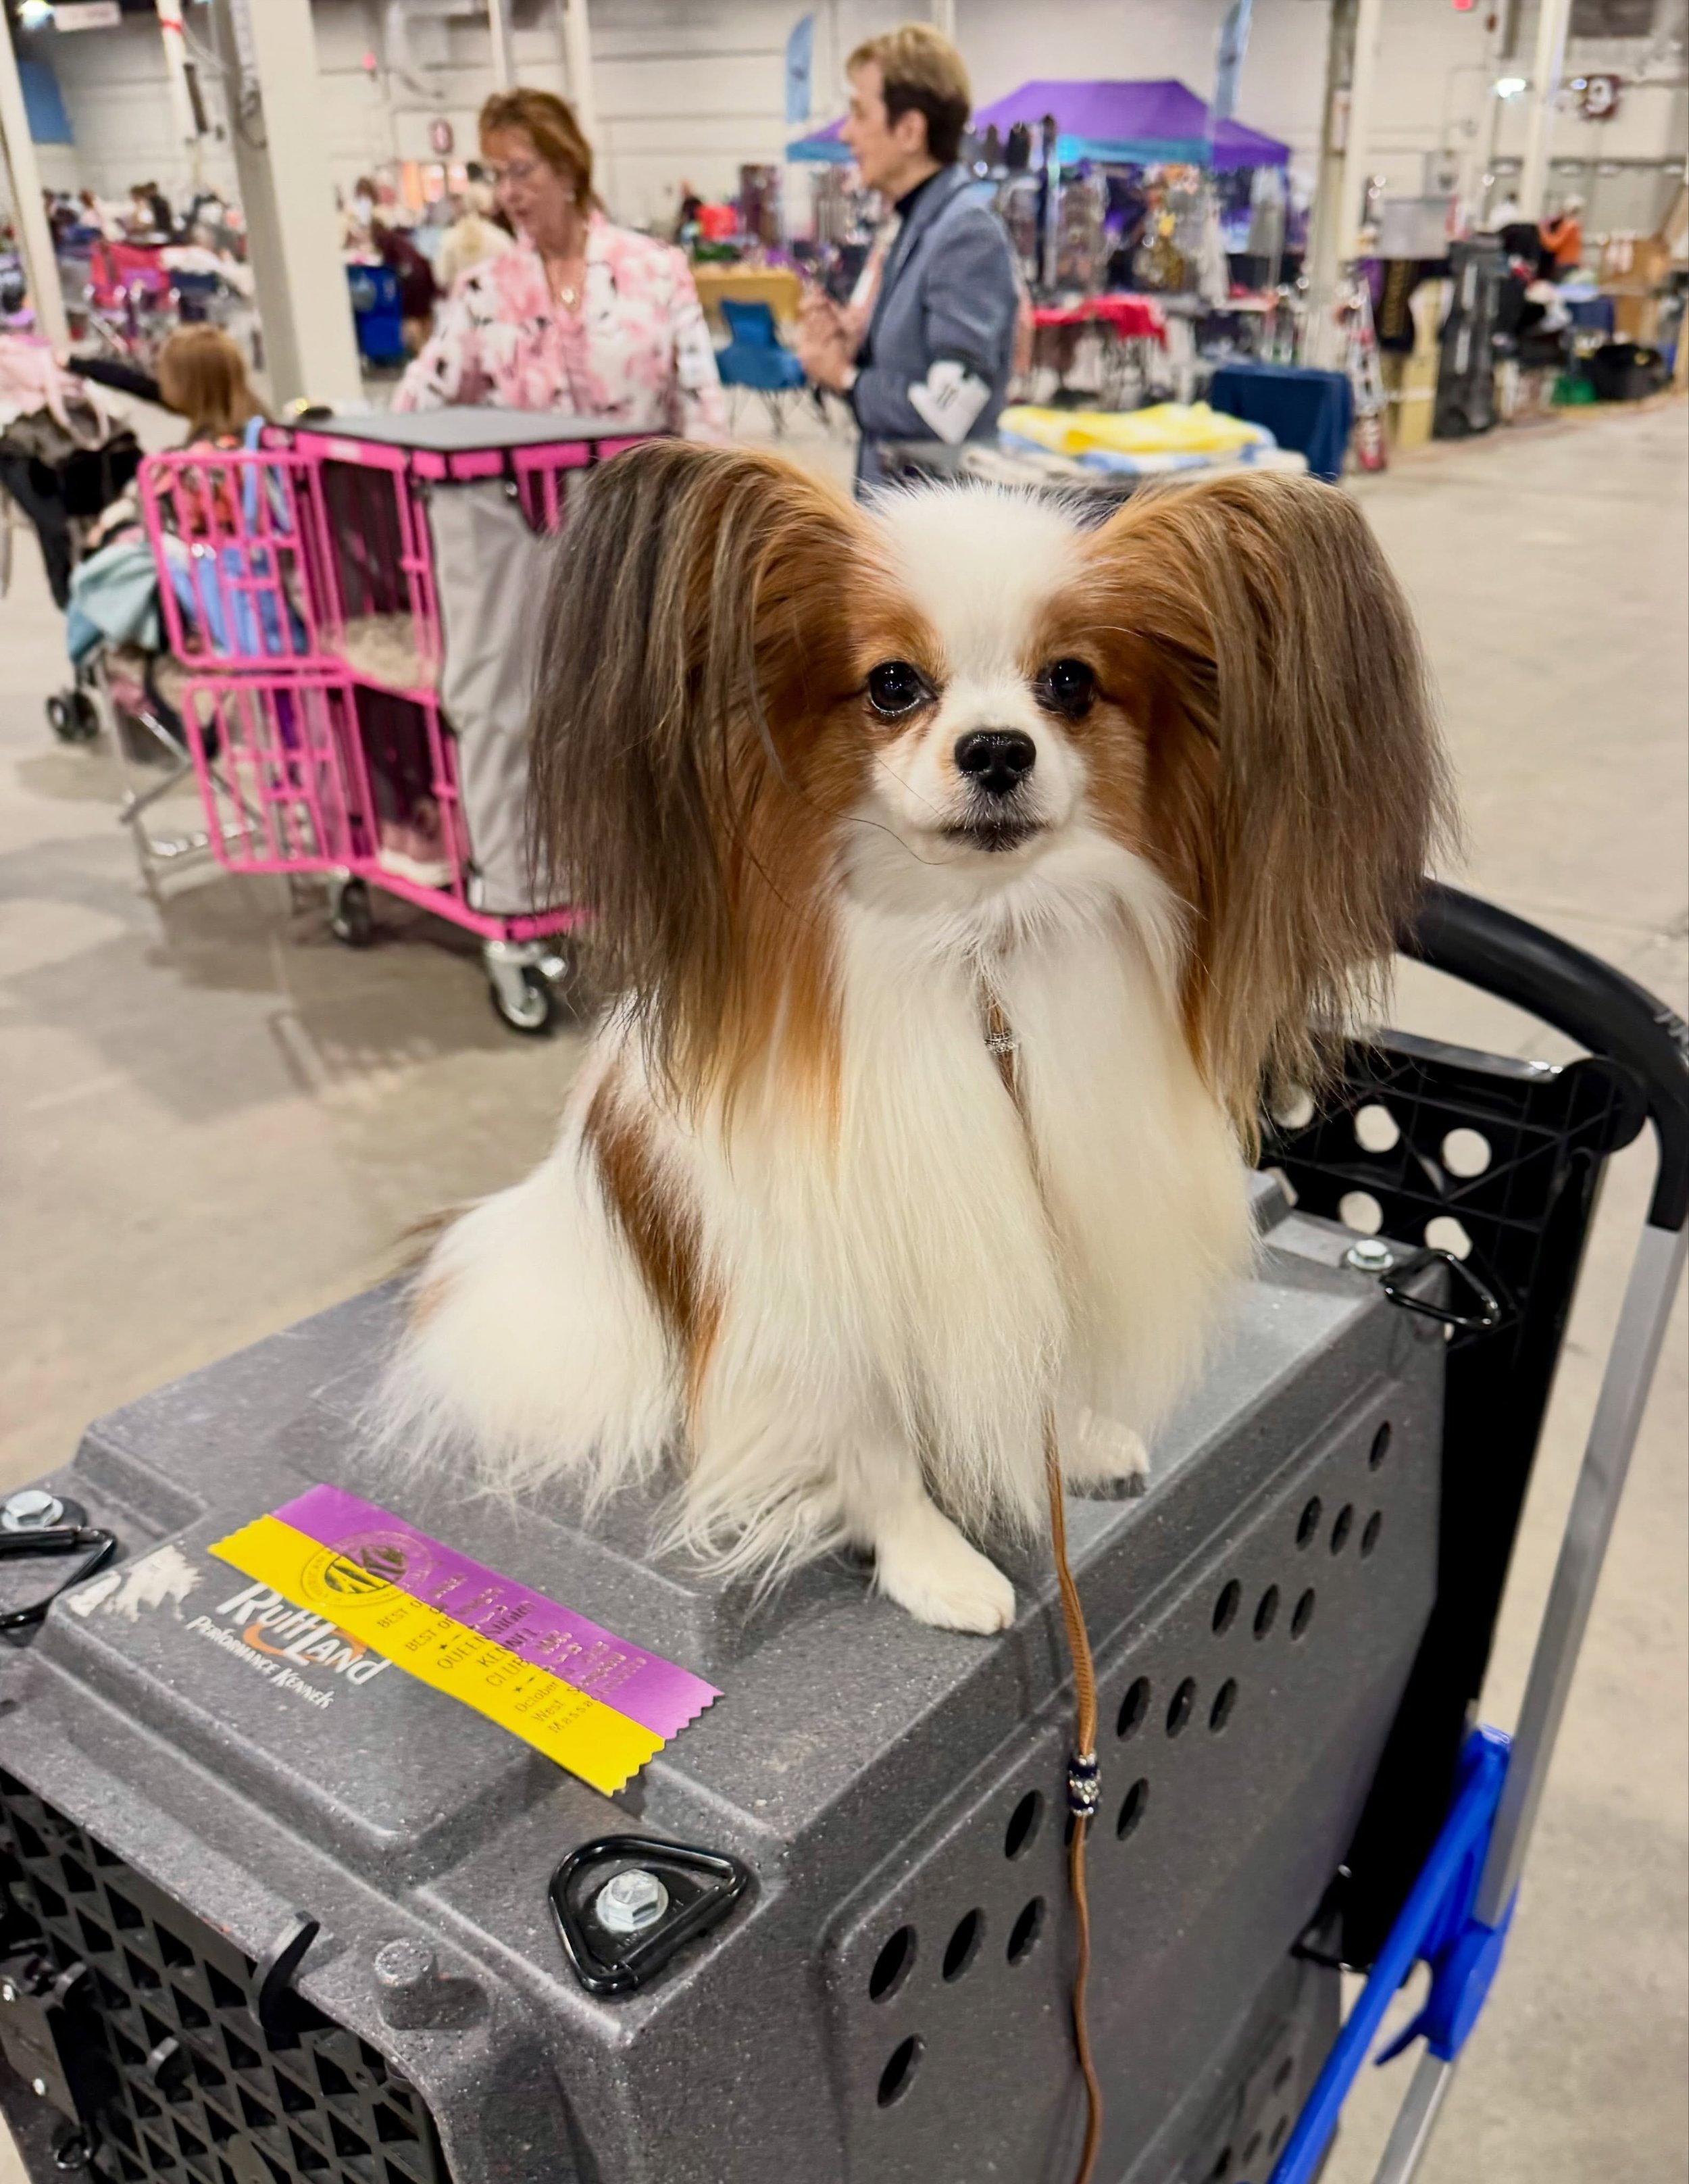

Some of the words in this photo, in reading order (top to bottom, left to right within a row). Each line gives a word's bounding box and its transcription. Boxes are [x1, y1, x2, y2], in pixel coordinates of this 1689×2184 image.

[377, 1608, 409, 1629] BEST
[405, 1629, 437, 1652] BEST
[477, 1627, 538, 1668] KENNEL
[514, 1680, 559, 1714] October
[530, 1698, 565, 1723] West
